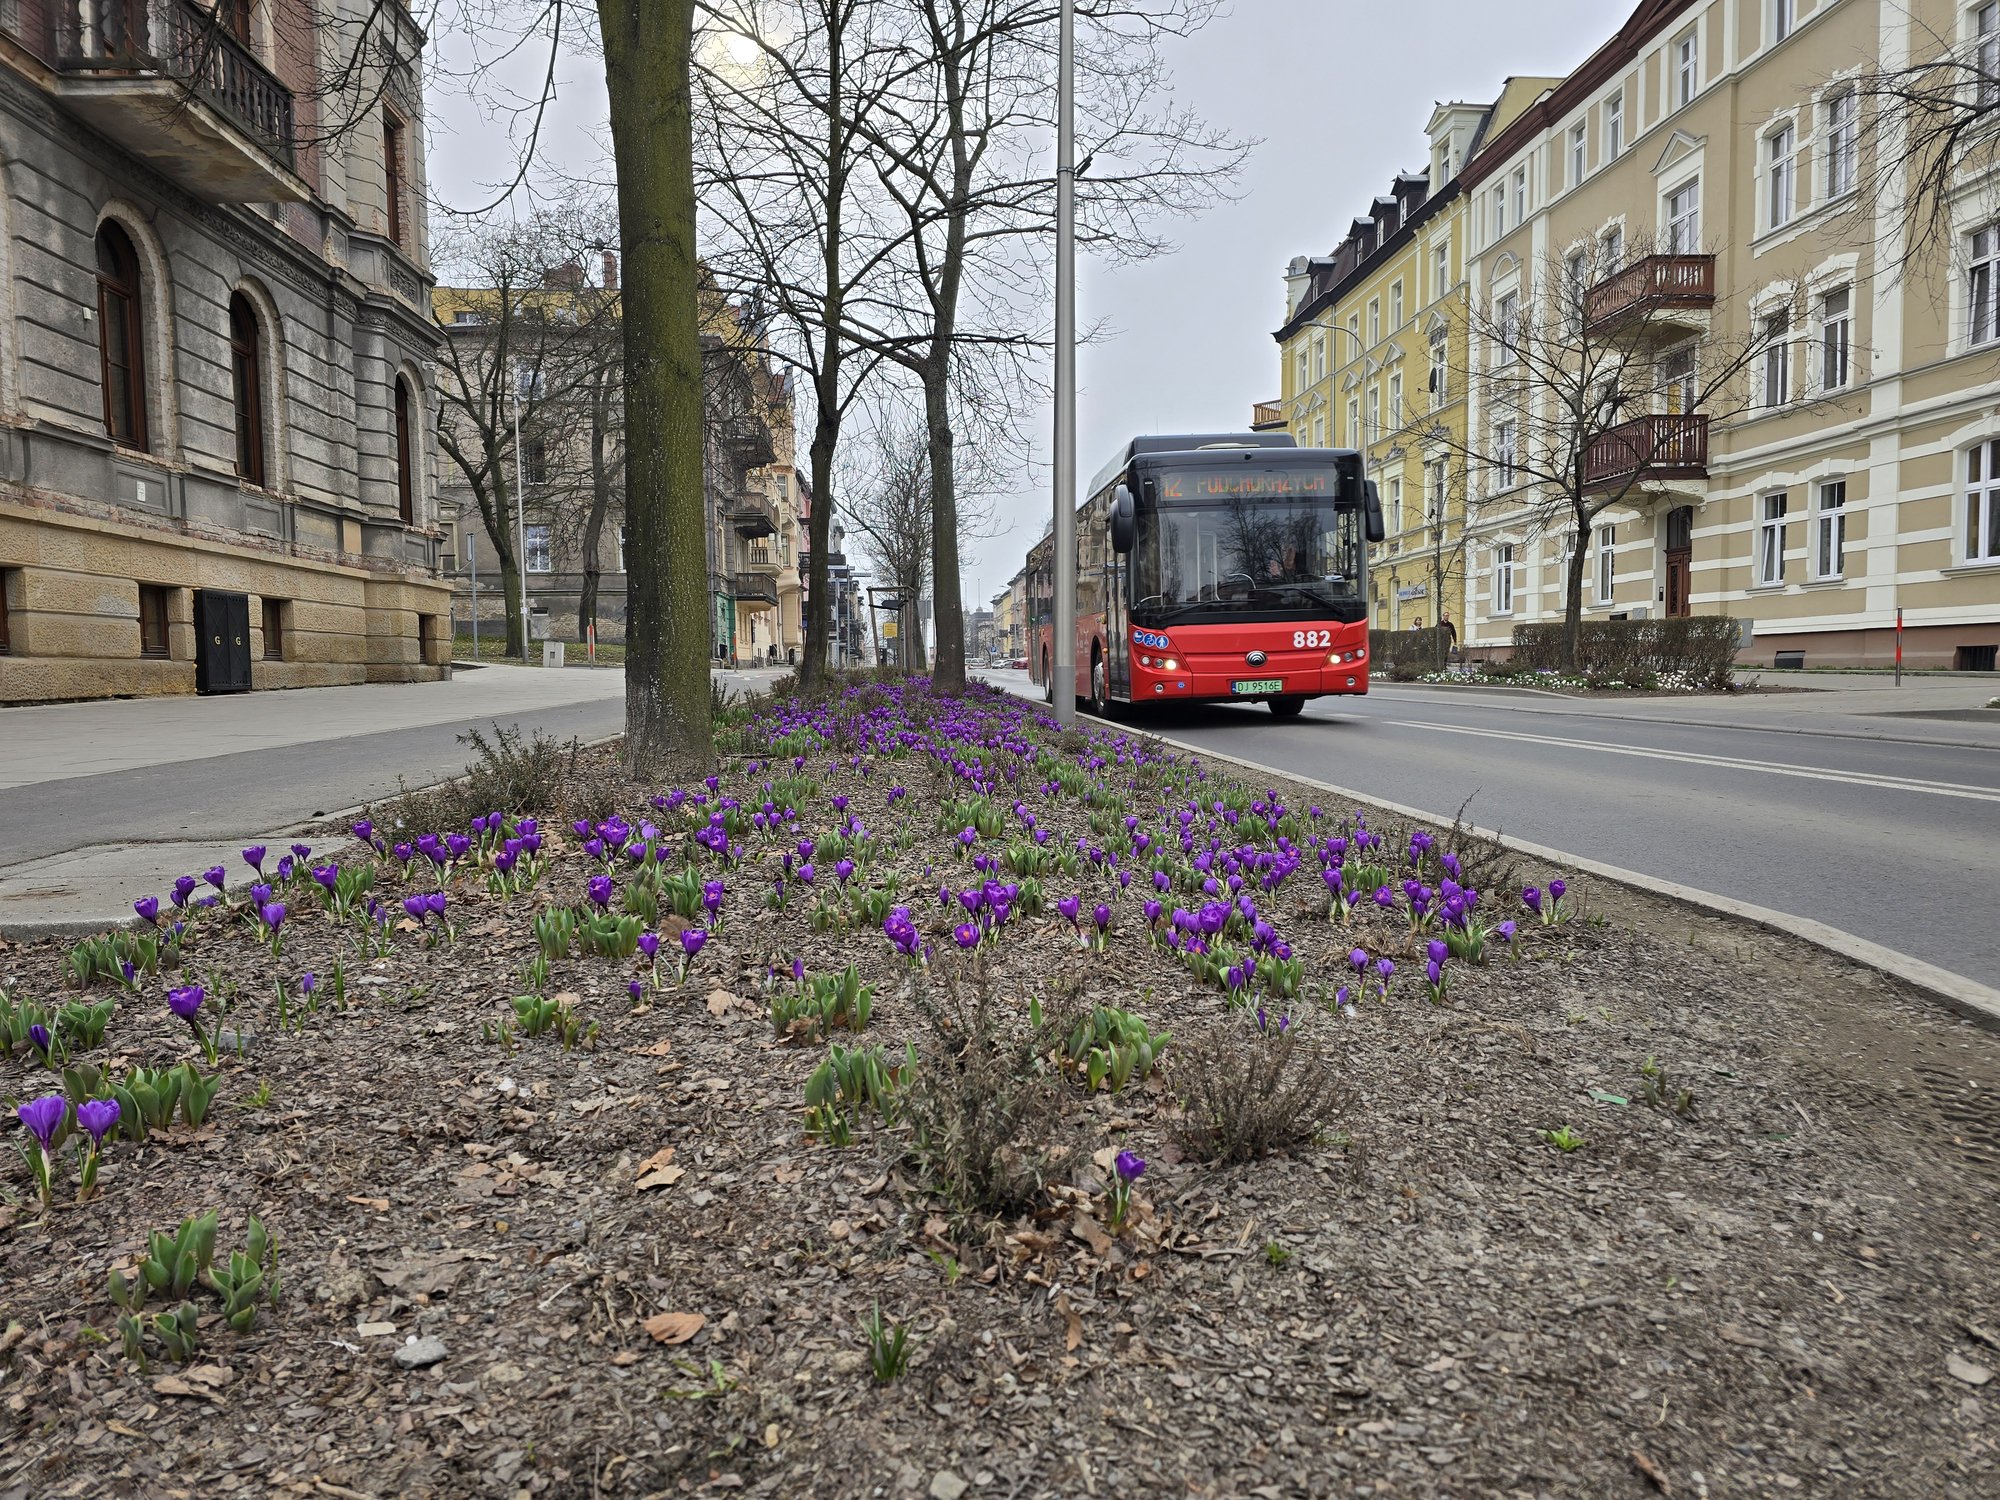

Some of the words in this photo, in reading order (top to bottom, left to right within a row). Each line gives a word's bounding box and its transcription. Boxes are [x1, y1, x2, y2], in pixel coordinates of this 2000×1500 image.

[1164, 477, 1182, 496] 12
[1293, 630, 1331, 648] 882
[1238, 682, 1248, 692] DJ
[1252, 681, 1280, 691] 9516E
